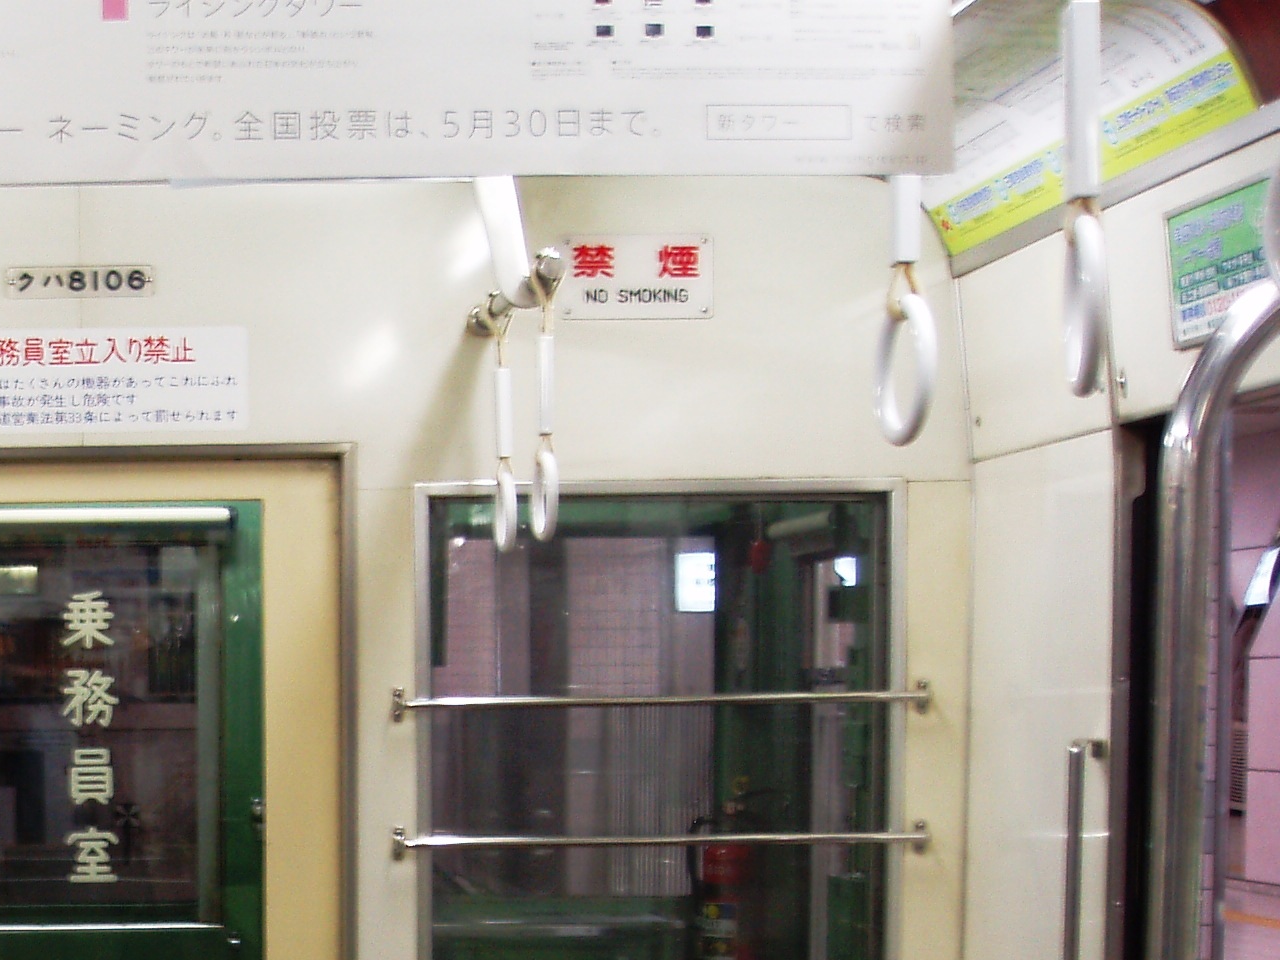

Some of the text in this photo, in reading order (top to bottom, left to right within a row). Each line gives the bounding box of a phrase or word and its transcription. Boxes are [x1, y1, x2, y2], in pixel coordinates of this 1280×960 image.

[572, 245, 700, 278] 禁煙
[19, 269, 147, 293] クハ8106
[584, 287, 689, 304] NO SMOKING
[62, 591, 119, 884] 乗務員室
